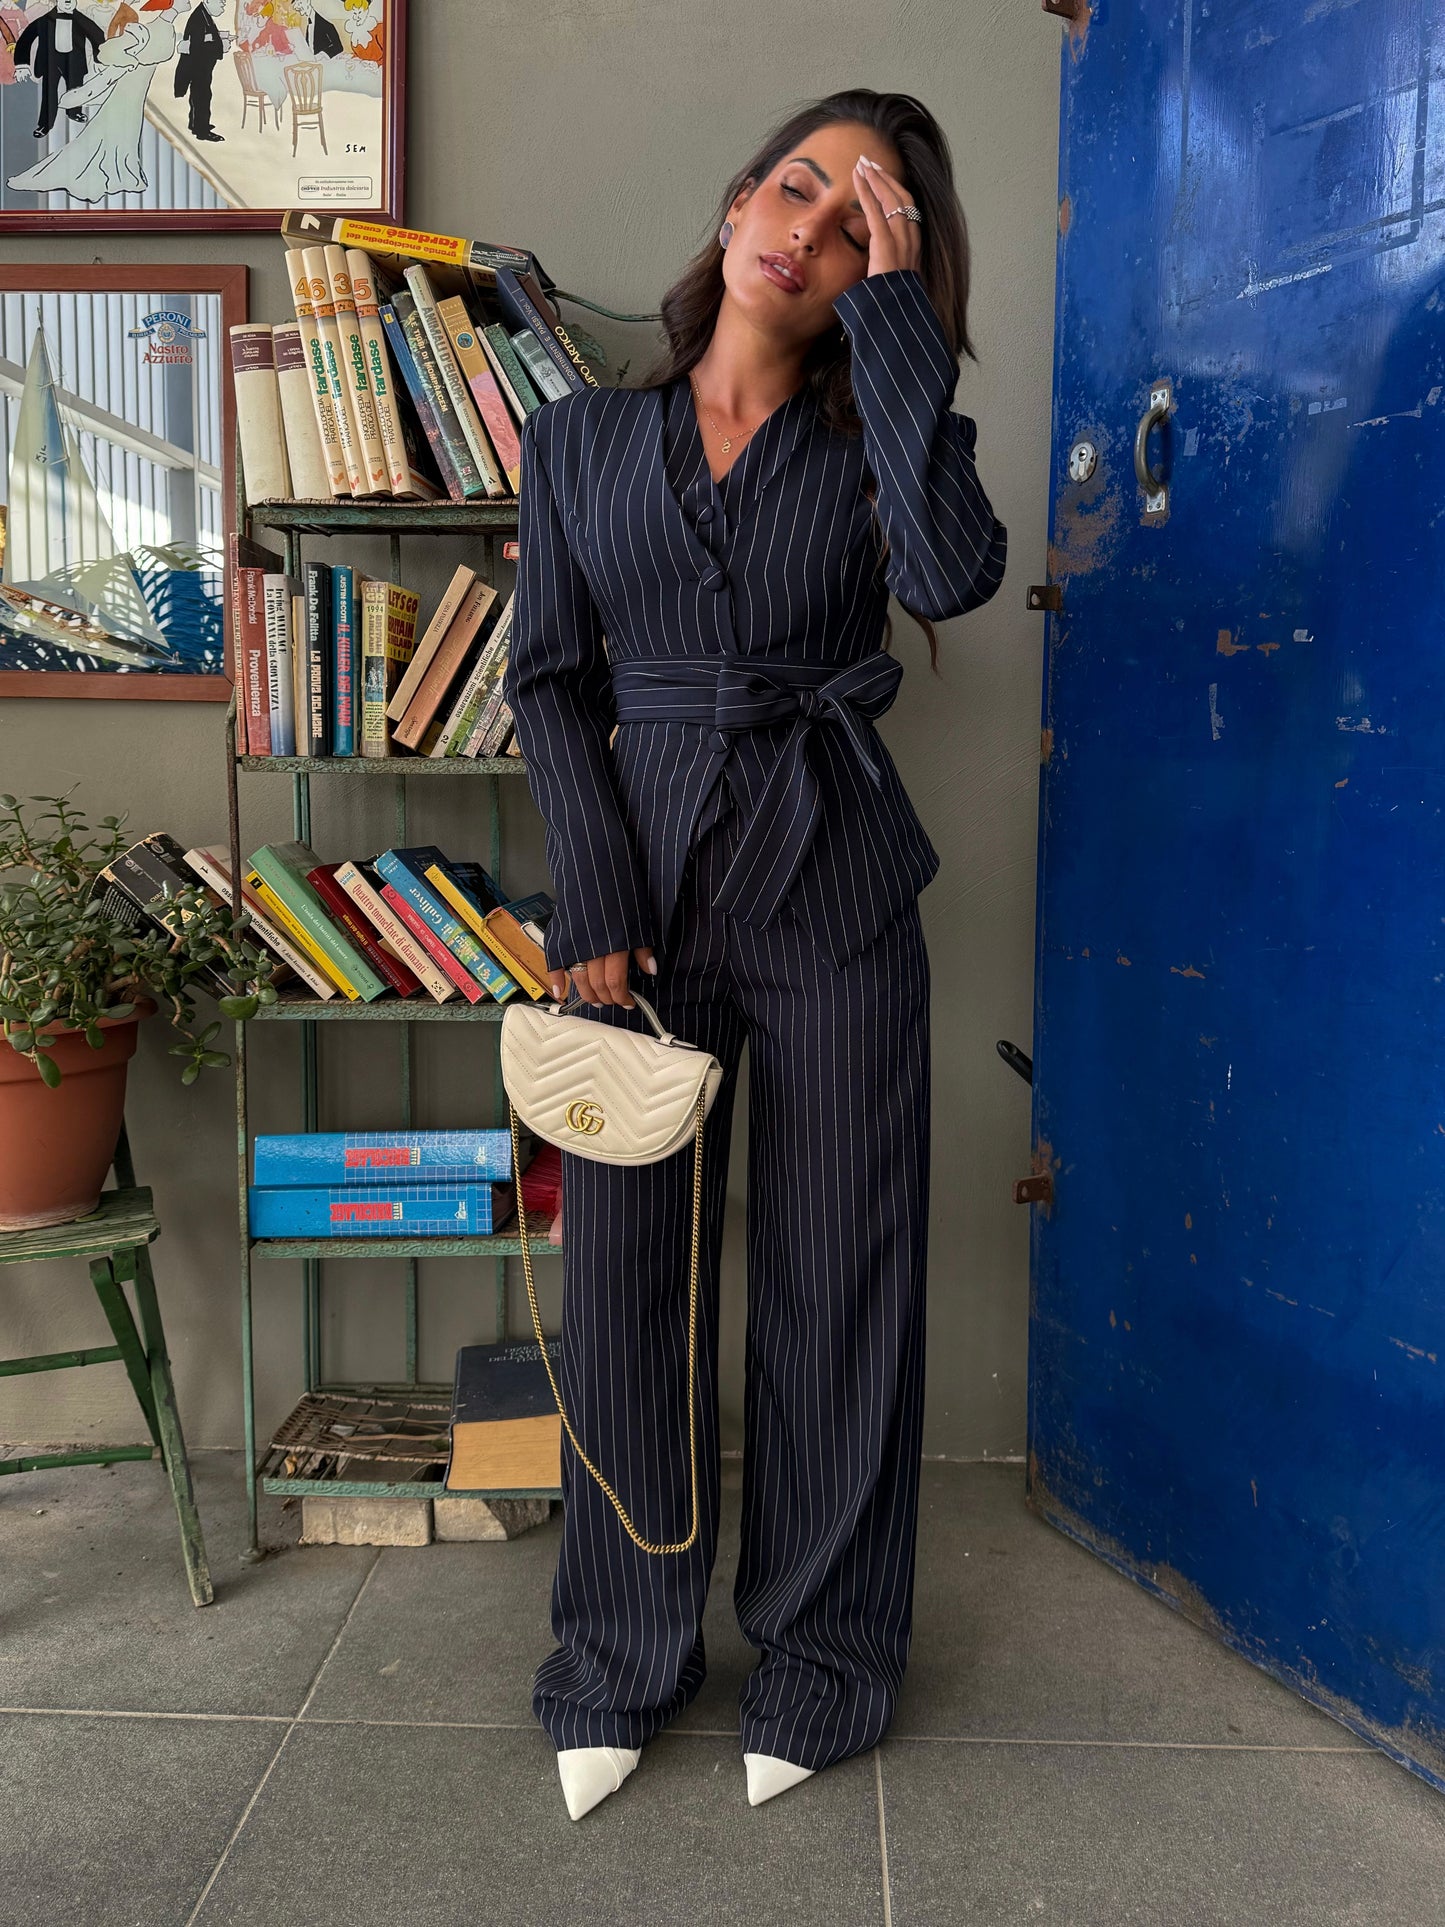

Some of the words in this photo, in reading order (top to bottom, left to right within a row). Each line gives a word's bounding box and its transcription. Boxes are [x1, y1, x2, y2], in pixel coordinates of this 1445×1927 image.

[345, 144, 366, 153] SEM
[300, 213, 321, 231] 7
[346, 232, 363, 241] del
[364, 235, 424, 252] enciclopedia
[424, 244, 457, 258] grande
[295, 277, 312, 298] 4
[308, 278, 326, 301] 6
[333, 273, 353, 295] 3
[353, 278, 372, 301] 5
[144, 312, 189, 328] PERONI
[522, 303, 533, 316] Vol.
[531, 315, 547, 336] PAESI
[148, 342, 188, 355] Nastro
[413, 329, 426, 351] TIGRI
[421, 350, 430, 361] DI
[421, 306, 447, 352] ANIMALI
[438, 351, 467, 406] D'EUROPA
[554, 325, 585, 365] ARTICO
[142, 352, 193, 364] Azzurro
[548, 343, 576, 381] CONTINENTI
[356, 393, 372, 441] ENCICLOPEDIA
[363, 399, 374, 416] DEL
[367, 416, 378, 440] PRATICA
[247, 570, 256, 591] Frank
[308, 570, 319, 596] Frank
[266, 588, 275, 598] La
[275, 588, 285, 612] Irving
[309, 596, 319, 612] De
[388, 589, 406, 611] LET'S
[406, 596, 418, 614] GO
[248, 591, 258, 625] McDonald
[267, 599, 278, 639] FONTANA
[367, 605, 384, 613] 1994
[276, 615, 287, 655] WALLACE
[309, 612, 320, 642] Felitta
[337, 623, 350, 634] IL
[268, 639, 278, 658] della
[337, 637, 351, 673] KILLER
[248, 649, 263, 717] Provenienza
[269, 659, 280, 711] GIOVINEZZA
[311, 664, 322, 694] PROVA
[456, 681, 477, 718] osservazioni
[474, 646, 495, 682] scientifiche
[311, 695, 322, 713] DEL
[337, 696, 351, 727] MARI
[312, 713, 323, 739] MARE
[200, 865, 209, 875] 1
[409, 887, 443, 925] Gulliver
[252, 917, 281, 947] scientifiche
[352, 883, 375, 911] Quattro
[371, 908, 400, 939] tonnellate
[395, 934, 405, 948] di
[401, 943, 430, 975] diamanti
[440, 922, 454, 935] di
